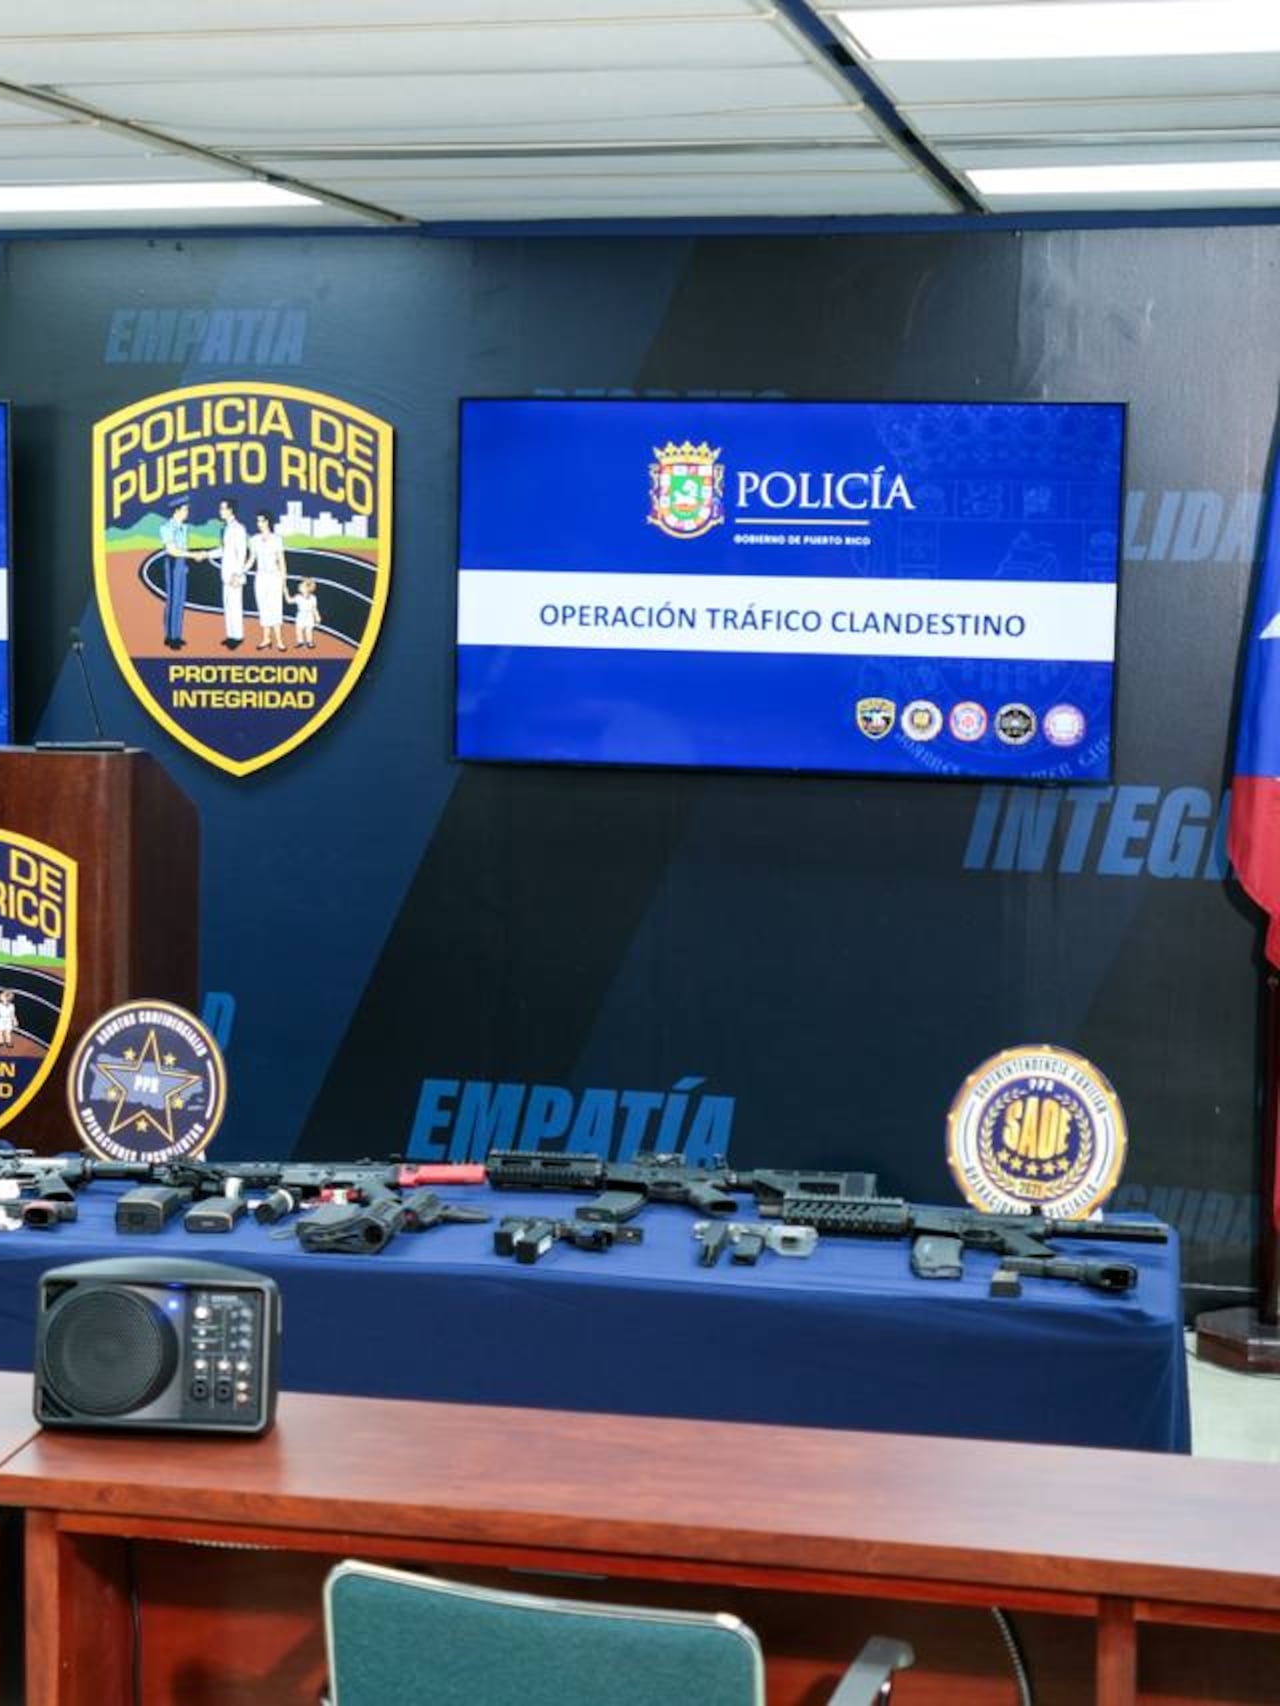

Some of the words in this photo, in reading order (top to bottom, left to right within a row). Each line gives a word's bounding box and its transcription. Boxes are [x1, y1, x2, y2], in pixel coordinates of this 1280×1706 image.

[110, 398, 293, 471] POLICIA
[310, 409, 375, 473] DE
[112, 441, 267, 519] PUERTO
[280, 444, 373, 517] RICO
[736, 465, 917, 510] POLICÍA
[733, 534, 786, 545] GOBIERNO
[788, 535, 801, 545] DE
[803, 536, 843, 546] PUERTO
[845, 536, 871, 547] RICO
[539, 601, 697, 631] OPERACIÓN
[706, 603, 822, 633] TRÁFICO
[830, 610, 1026, 637] CLANDESTINO
[168, 664, 318, 685] PROTECCION
[172, 689, 315, 709] INTEGRIDAD
[962, 784, 1232, 880] INTEG
[9, 850, 62, 903] DE
[406, 1076, 736, 1169] EMPATÍA
